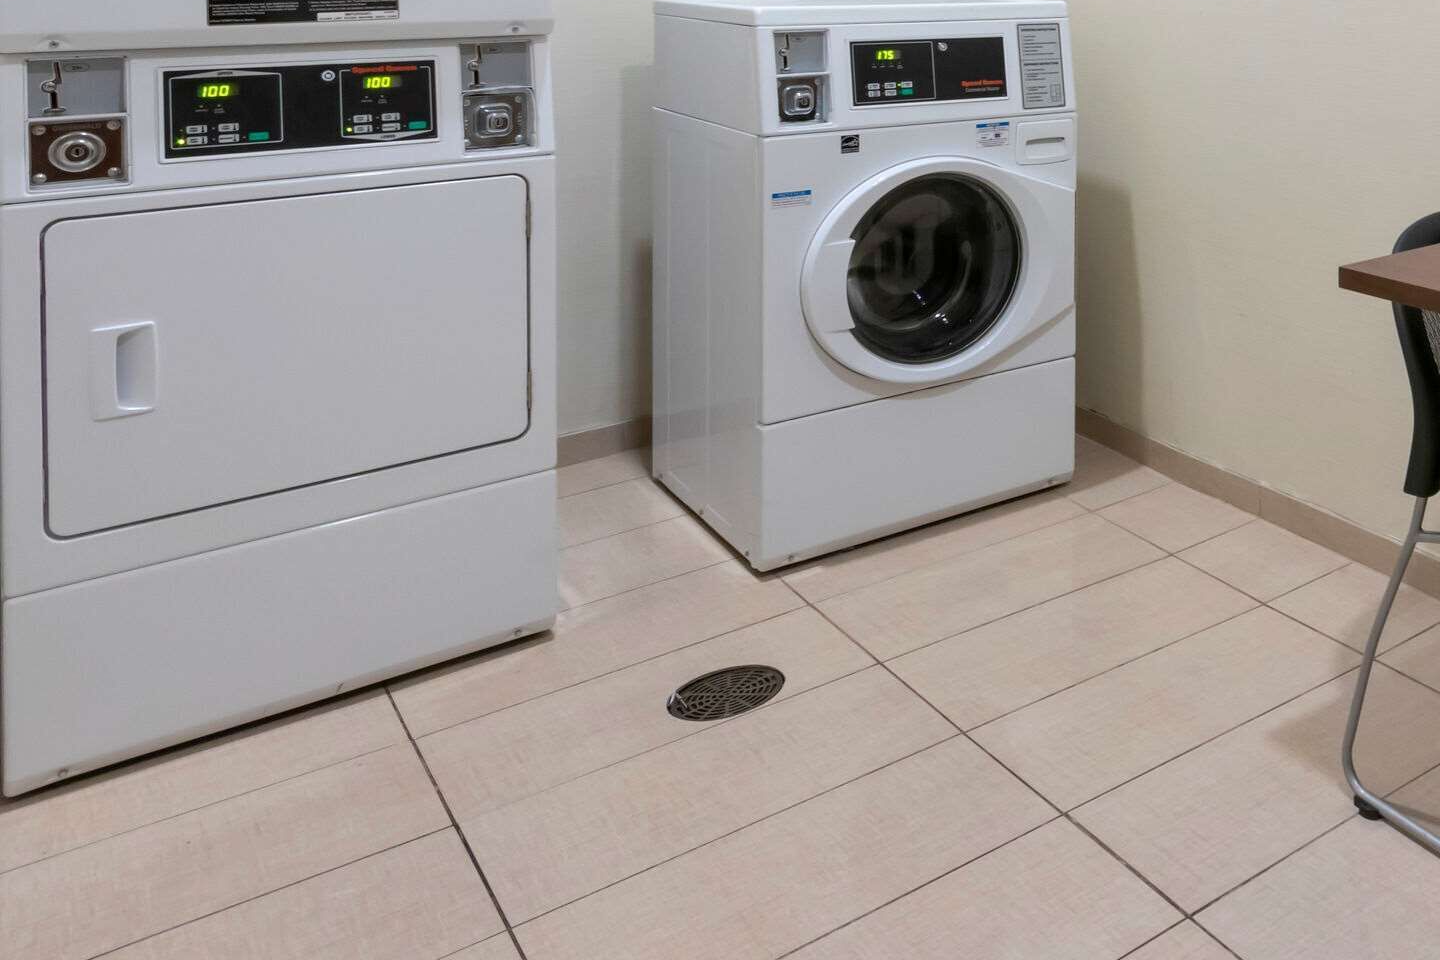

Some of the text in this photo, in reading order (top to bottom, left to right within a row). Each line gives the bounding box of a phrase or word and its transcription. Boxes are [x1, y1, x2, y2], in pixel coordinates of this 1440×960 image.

[877, 50, 895, 60] 175
[366, 76, 391, 89] 100
[202, 85, 230, 97] 100
